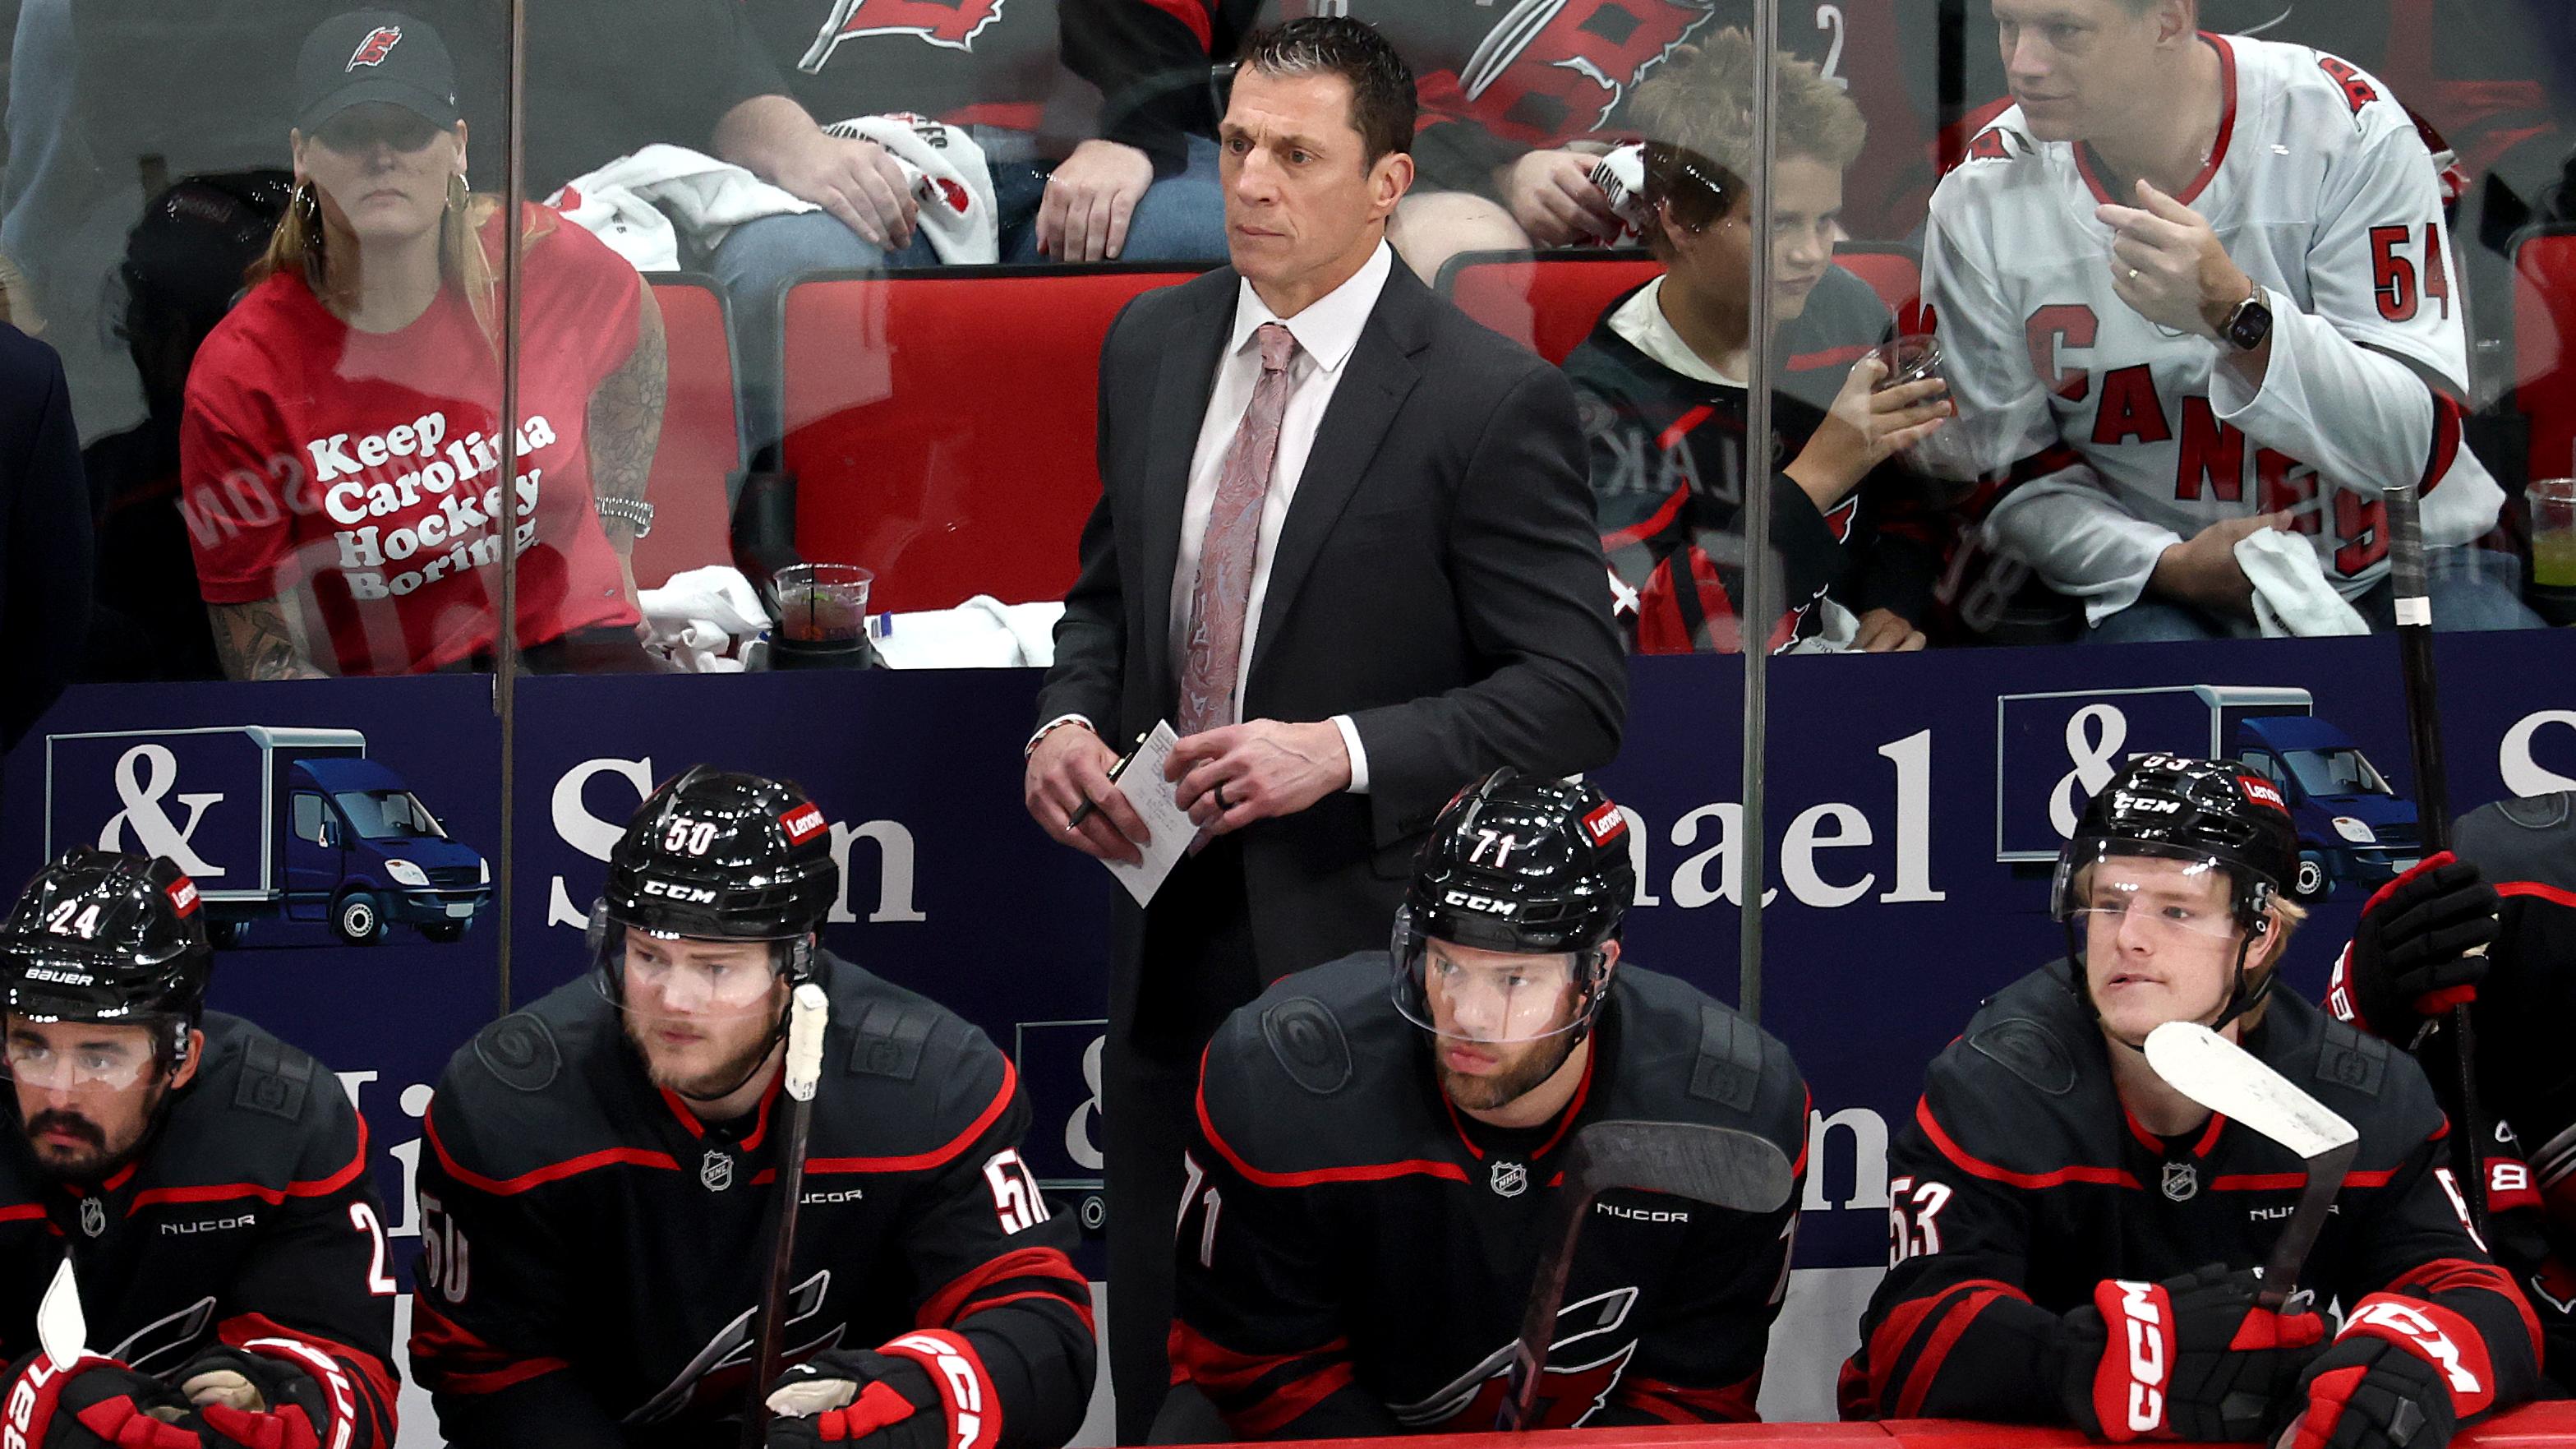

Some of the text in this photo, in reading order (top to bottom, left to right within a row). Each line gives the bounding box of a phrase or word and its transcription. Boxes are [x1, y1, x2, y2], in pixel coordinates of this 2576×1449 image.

[2369, 223, 2448, 322] 54
[306, 411, 446, 482] Keep
[2025, 303, 2389, 577] CANES
[325, 415, 557, 524] Carolina
[334, 468, 541, 568] Hockey
[99, 744, 225, 877] &
[2114, 797, 2181, 814] CCM
[665, 818, 717, 856] 50
[1469, 828, 1516, 868] 71
[643, 880, 717, 903] CCM
[1445, 891, 1518, 916] CCM
[49, 899, 100, 939] 24
[25, 967, 94, 986] BAUER
[160, 1214, 256, 1234] NUCOR
[1597, 1202, 1689, 1222] NUCOR
[351, 1201, 398, 1293] 2
[2114, 1279, 2164, 1433] CCM
